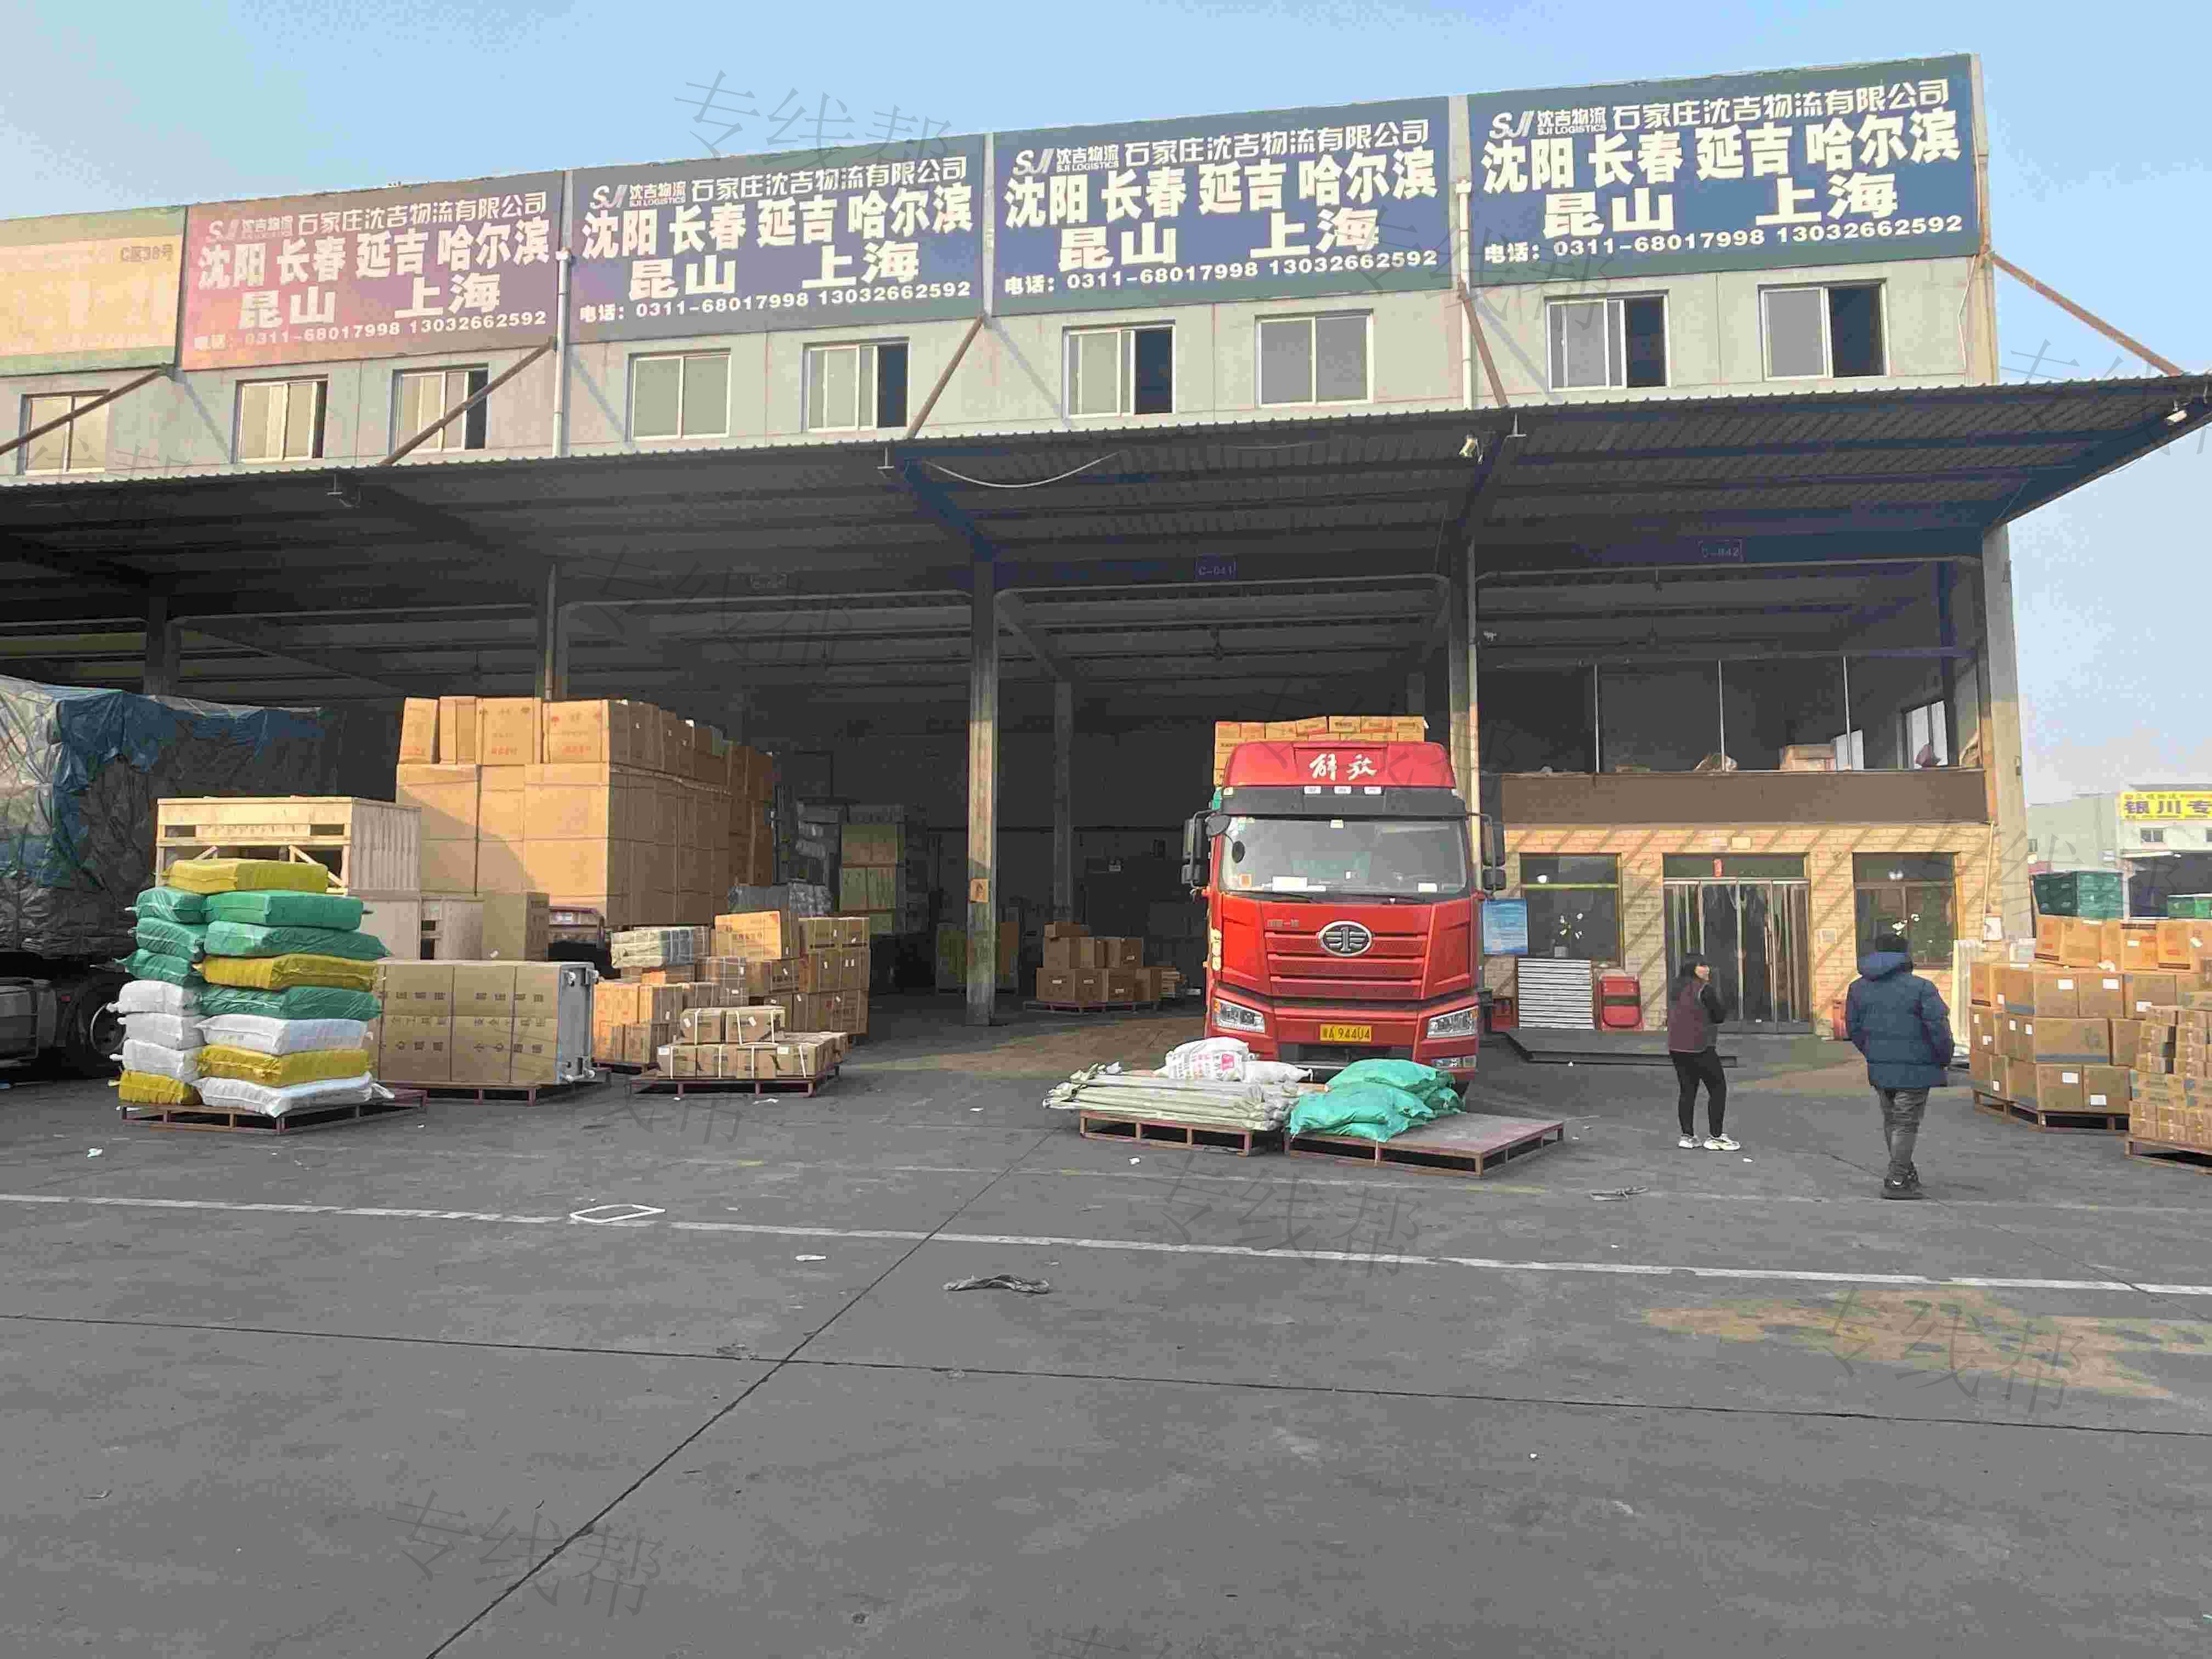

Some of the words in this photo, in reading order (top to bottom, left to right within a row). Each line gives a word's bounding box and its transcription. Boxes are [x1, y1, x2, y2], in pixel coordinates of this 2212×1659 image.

[1537, 106, 1606, 127] 沈吉物流
[1612, 78, 1949, 131] 石家庄沈吉物流有限公司
[1056, 144, 1119, 164] 沈吉物流
[1125, 119, 1429, 167] 石家庄沈吉物流有限公司
[1480, 137, 1575, 193] 沈阳
[1588, 130, 1684, 188] 长春
[1695, 121, 1793, 182] 延吉
[1805, 107, 1961, 172] 哈尔滨
[630, 181, 686, 199] 沈吉物流
[692, 156, 966, 201] 石家庄沈吉物流有限公司
[1004, 174, 1088, 228] 沈阳
[1101, 166, 1187, 224] 长春
[1198, 158, 1286, 215] 延吉
[1298, 145, 1438, 207] 哈尔滨
[298, 192, 546, 235] 石家庄沈吉物流有限公司
[582, 208, 658, 259] 沈阳
[669, 202, 747, 255] 长春
[757, 194, 838, 247] 延吉
[848, 182, 973, 240] 哈尔滨
[1542, 187, 1674, 240] 昆山
[1755, 171, 1898, 227] 上海
[198, 243, 267, 289] 沈阳
[276, 235, 346, 285] 长春
[356, 228, 429, 279] 延吉
[437, 216, 549, 271] 哈尔滨
[1058, 222, 1177, 272] 昆山
[1250, 207, 1379, 259] 上海
[1553, 228, 1765, 256] 0311-68017998
[1777, 215, 1962, 243] 13032662592
[628, 254, 736, 301] 昆山
[802, 240, 919, 289] 上海
[1066, 261, 1258, 289] 0311-68017998
[1269, 250, 1438, 275] 13032662592
[238, 286, 336, 330] 昆山
[394, 272, 500, 319] 上海
[636, 291, 809, 318] 0311-68017998
[819, 281, 970, 305] 13032662592
[245, 322, 400, 344] 0311-68017998
[410, 311, 546, 333] 13032662592
[1309, 753, 1378, 781] 解放
